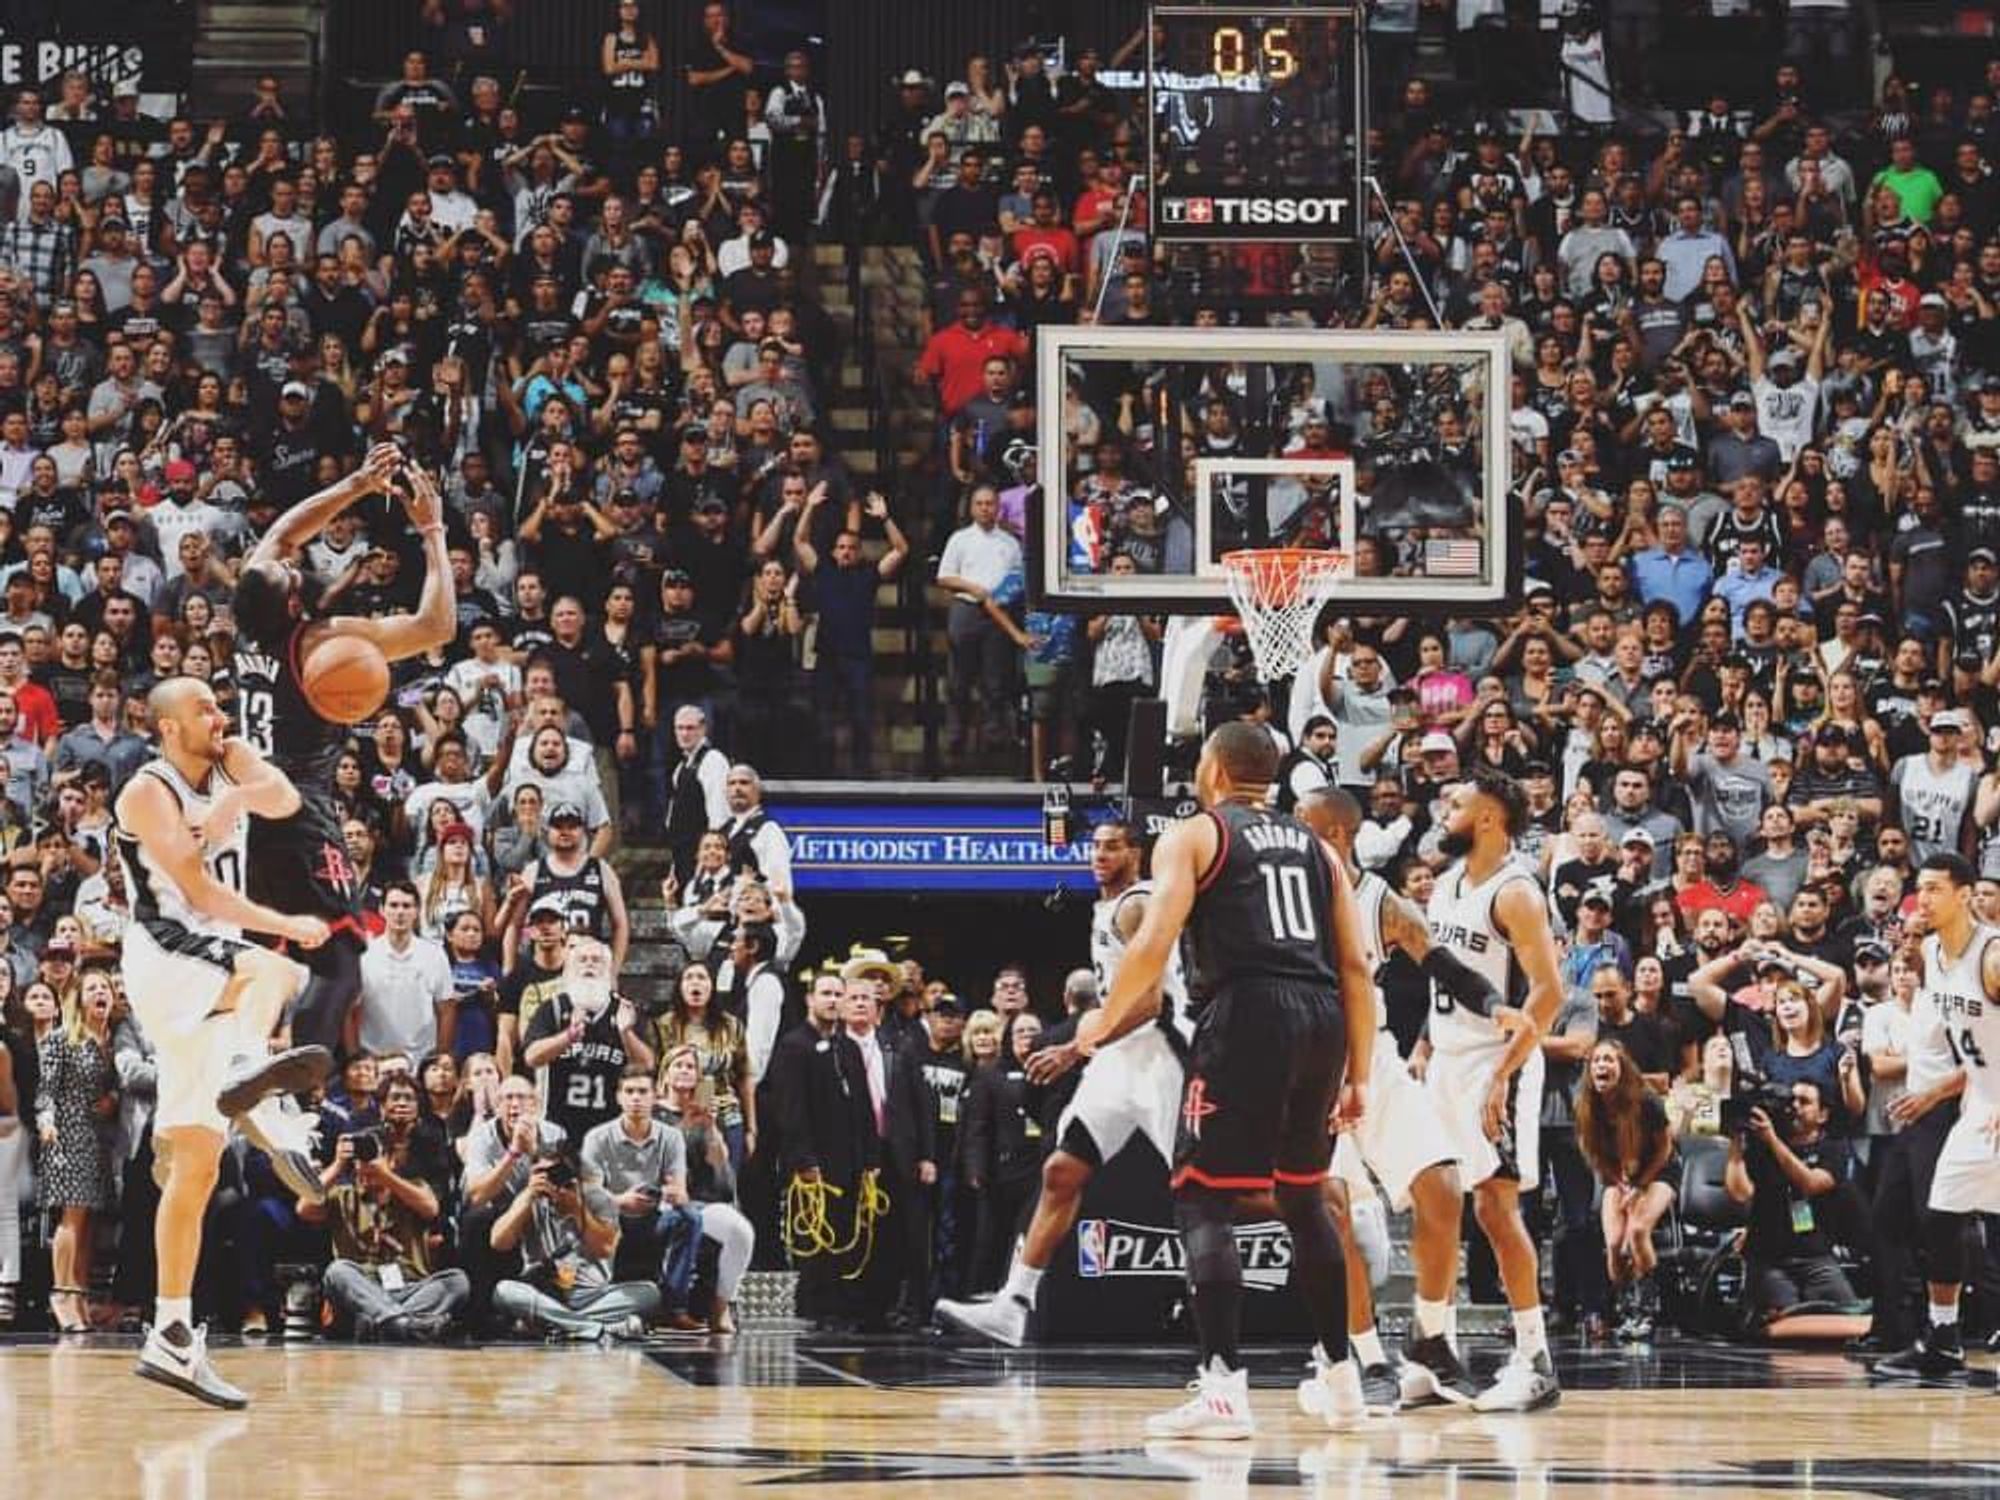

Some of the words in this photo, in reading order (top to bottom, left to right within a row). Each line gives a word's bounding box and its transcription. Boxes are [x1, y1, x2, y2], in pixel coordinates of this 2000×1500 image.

[1214, 198, 1348, 224] TISSOT
[239, 687, 274, 758] 13
[1258, 863, 1316, 939] 10
[1945, 1027, 1987, 1068] 14
[567, 1074, 607, 1109] 21
[1105, 1235, 1293, 1270] PLAYFFS
